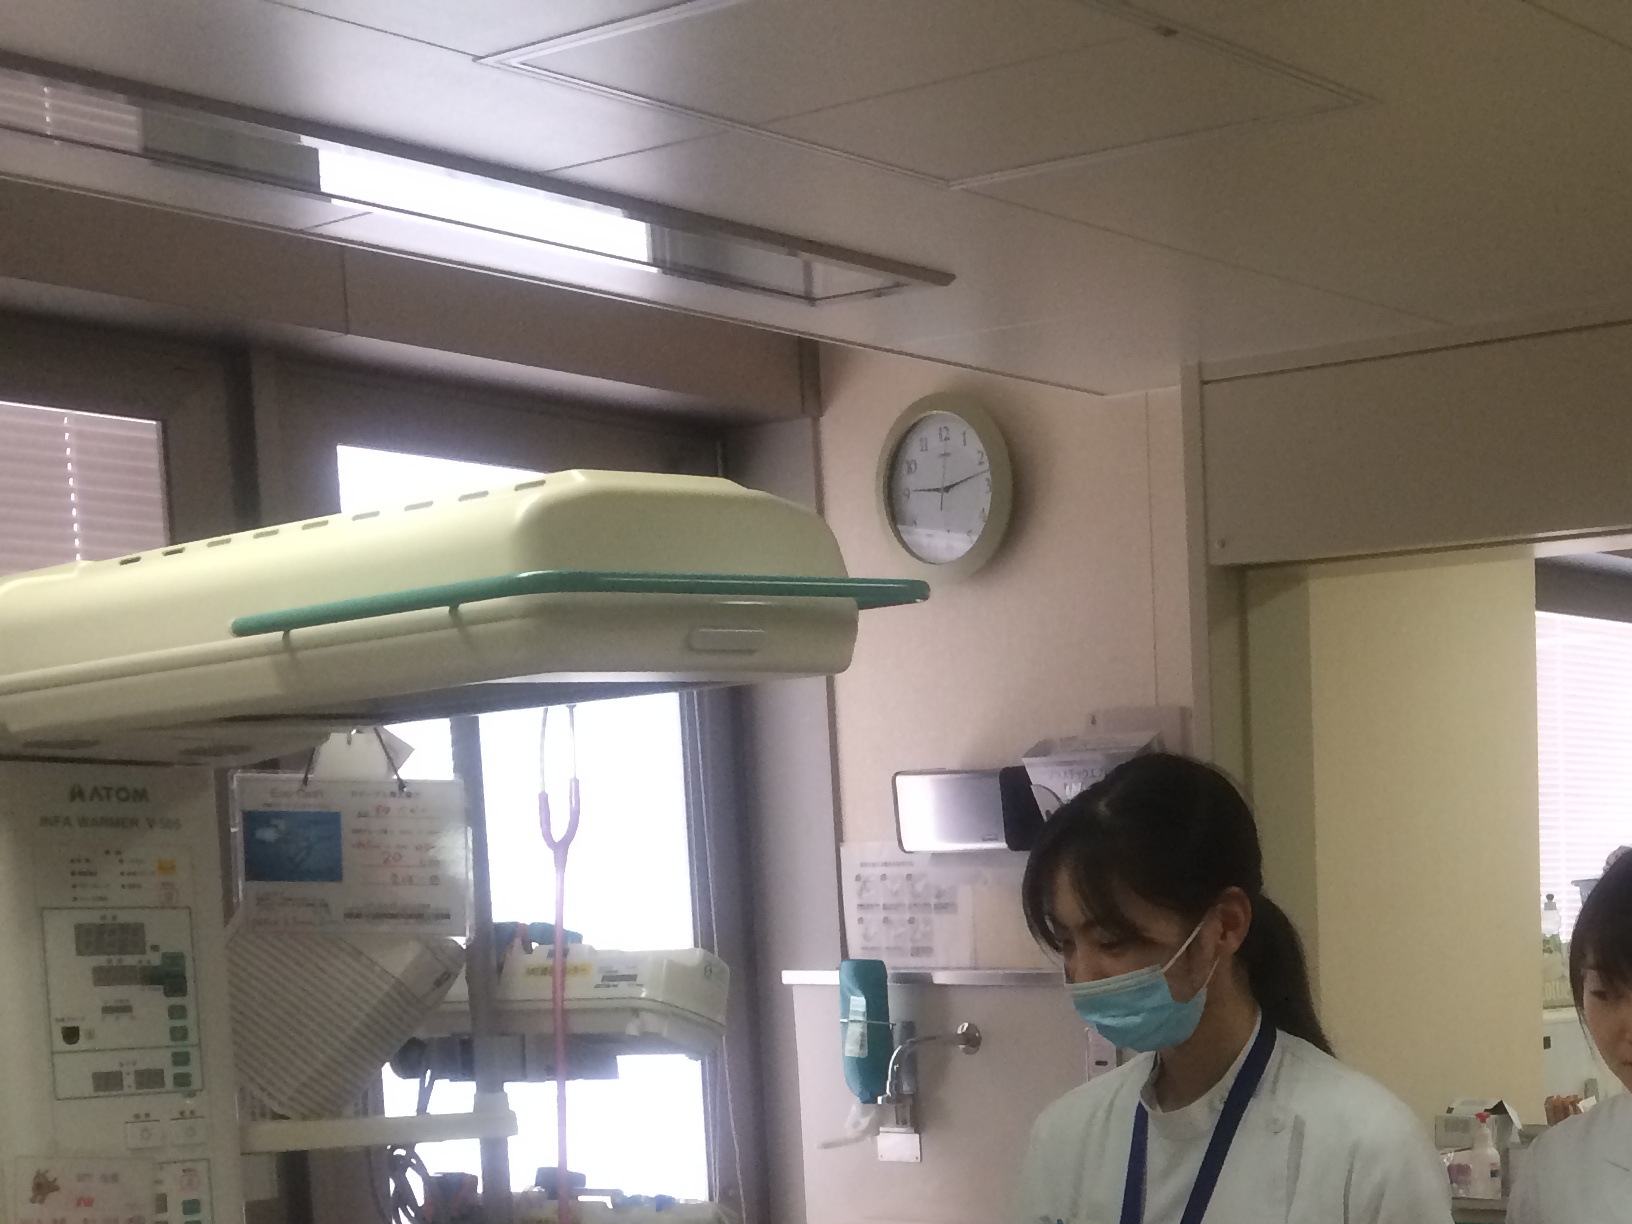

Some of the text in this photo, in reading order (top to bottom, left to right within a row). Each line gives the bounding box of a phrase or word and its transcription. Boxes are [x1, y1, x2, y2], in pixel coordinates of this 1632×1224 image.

[938, 426, 950, 442] 12
[961, 430, 967, 447] 1
[919, 437, 928, 452] 11
[977, 450, 985, 466] 2
[905, 459, 917, 475] 10
[903, 487, 911, 502] 9
[89, 786, 149, 803] ATOM
[39, 816, 72, 828] INFA
[77, 816, 139, 829] WARMER
